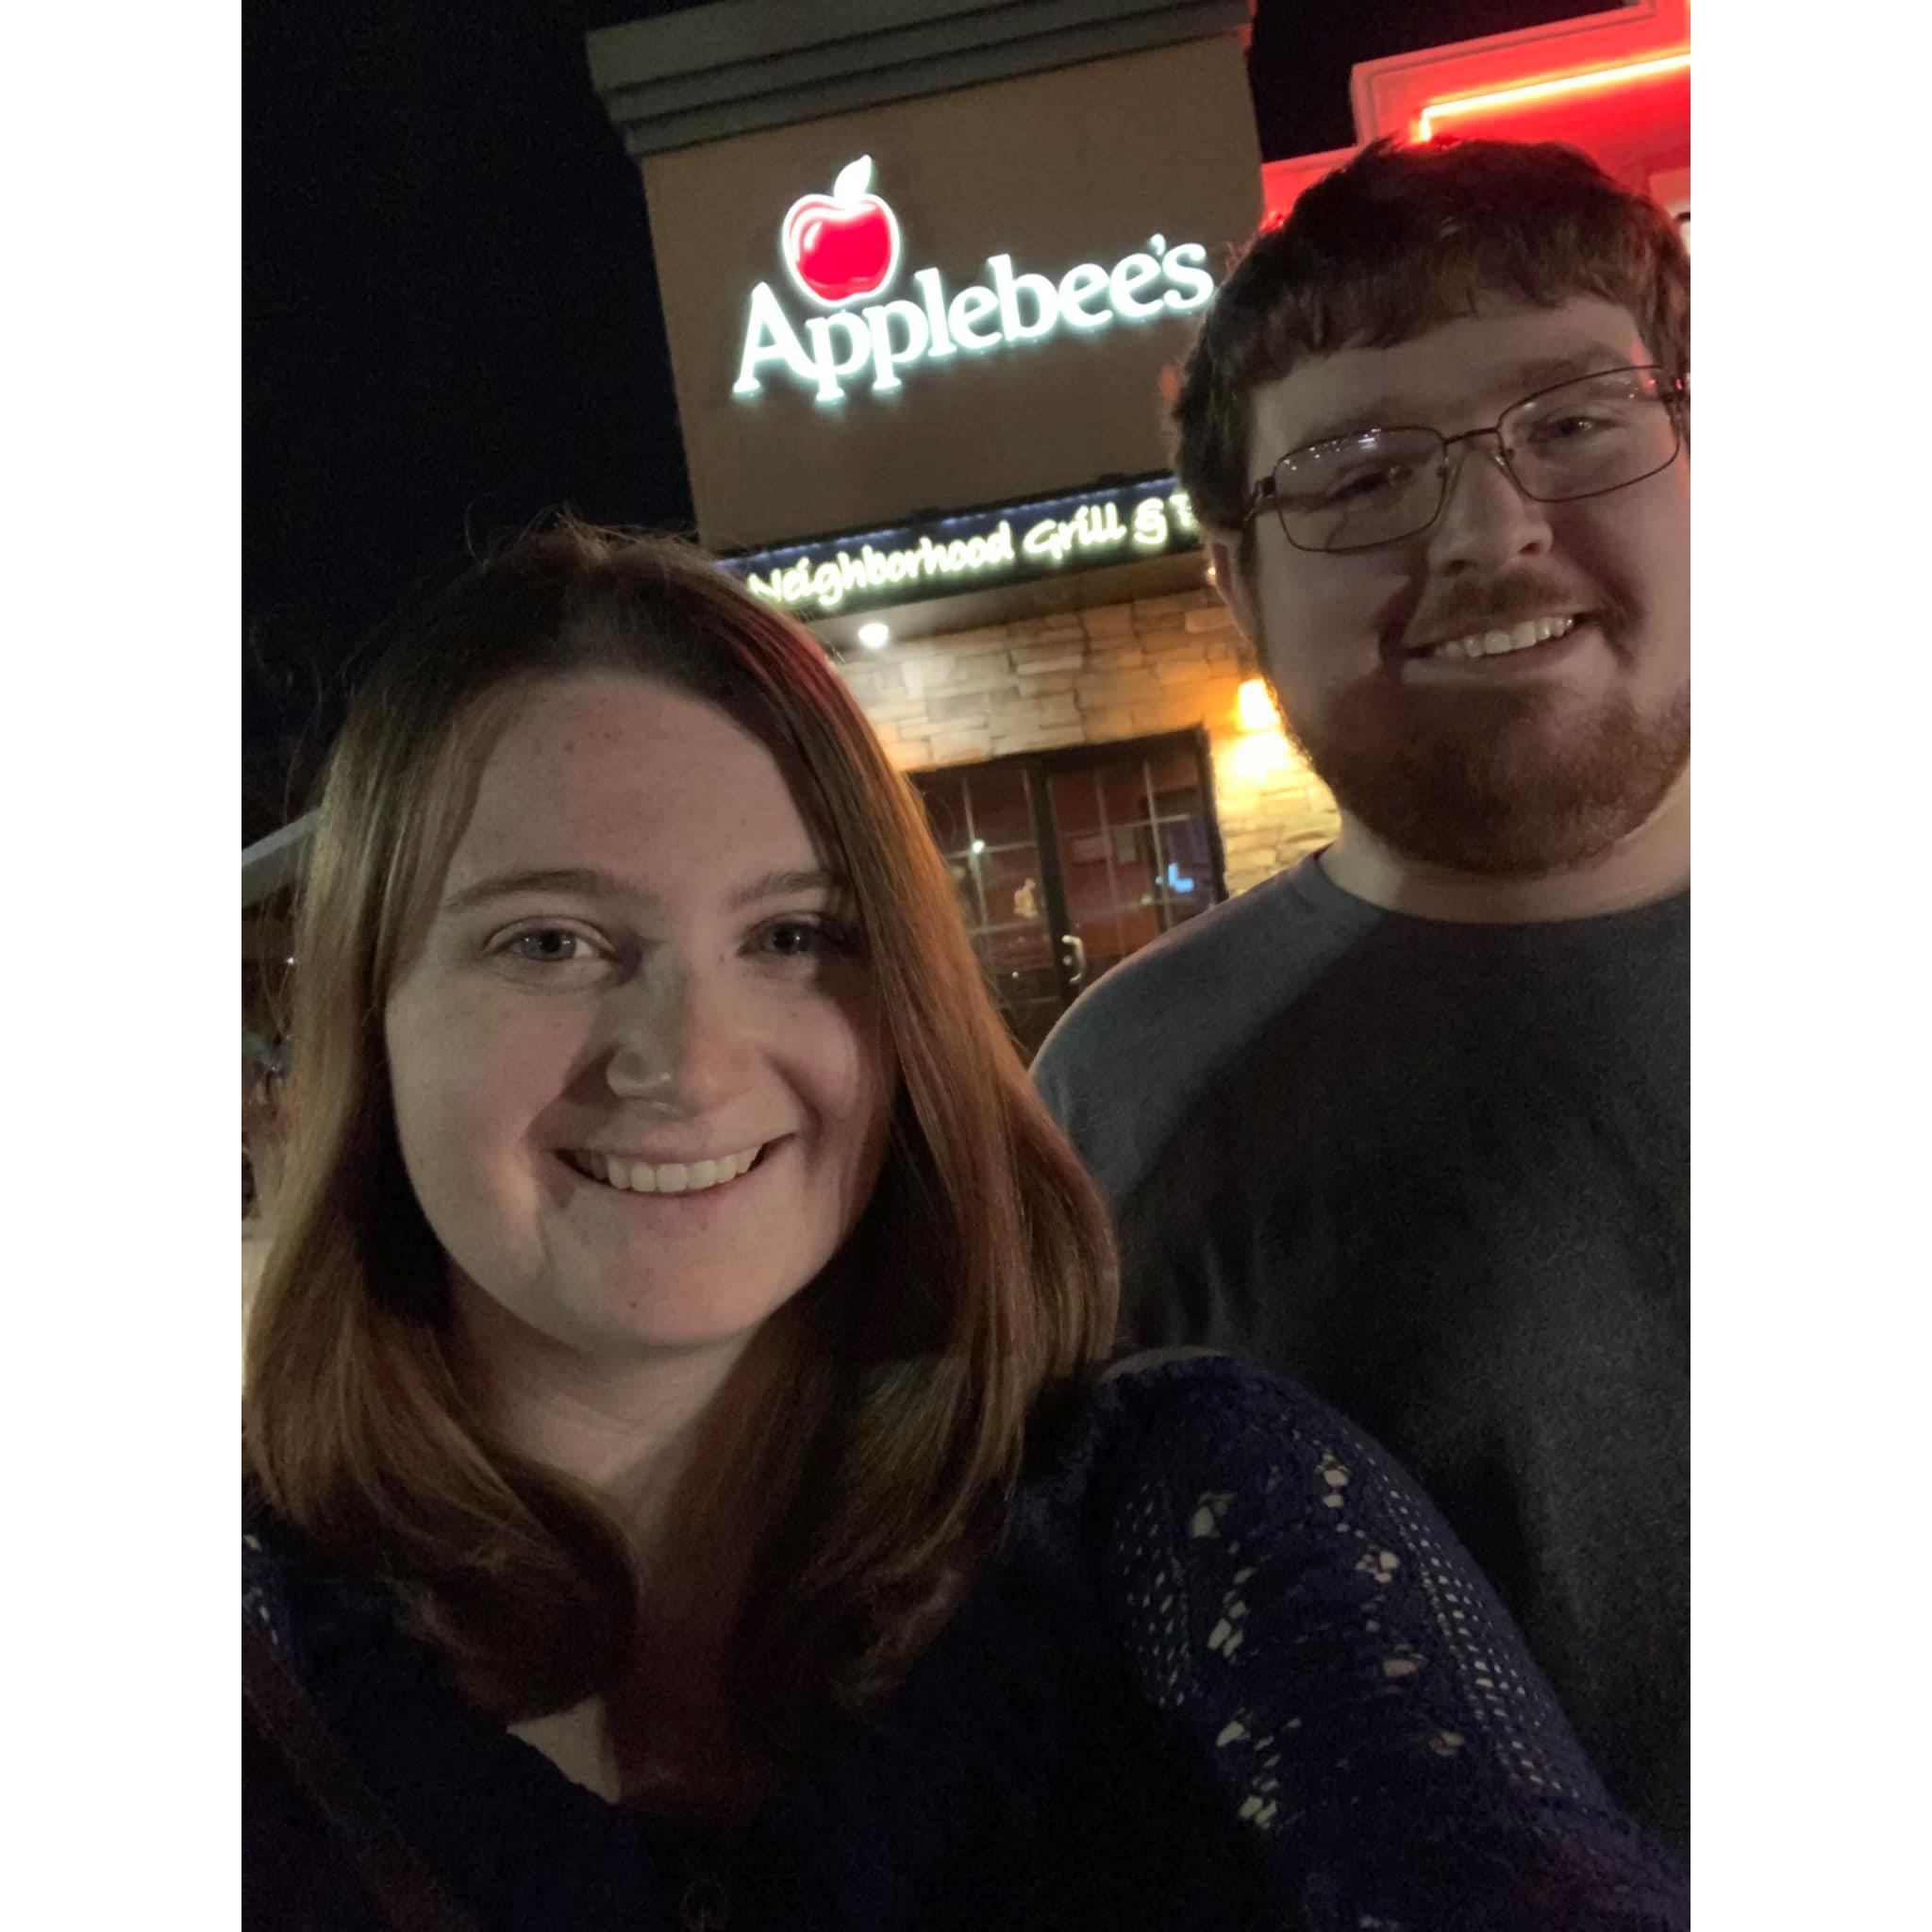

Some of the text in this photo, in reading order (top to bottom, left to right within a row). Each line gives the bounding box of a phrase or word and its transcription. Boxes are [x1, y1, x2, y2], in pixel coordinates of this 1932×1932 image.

[732, 232, 1214, 402] Applebee's
[746, 519, 1016, 606] Neighborhood
[1022, 501, 1128, 559] Grill
